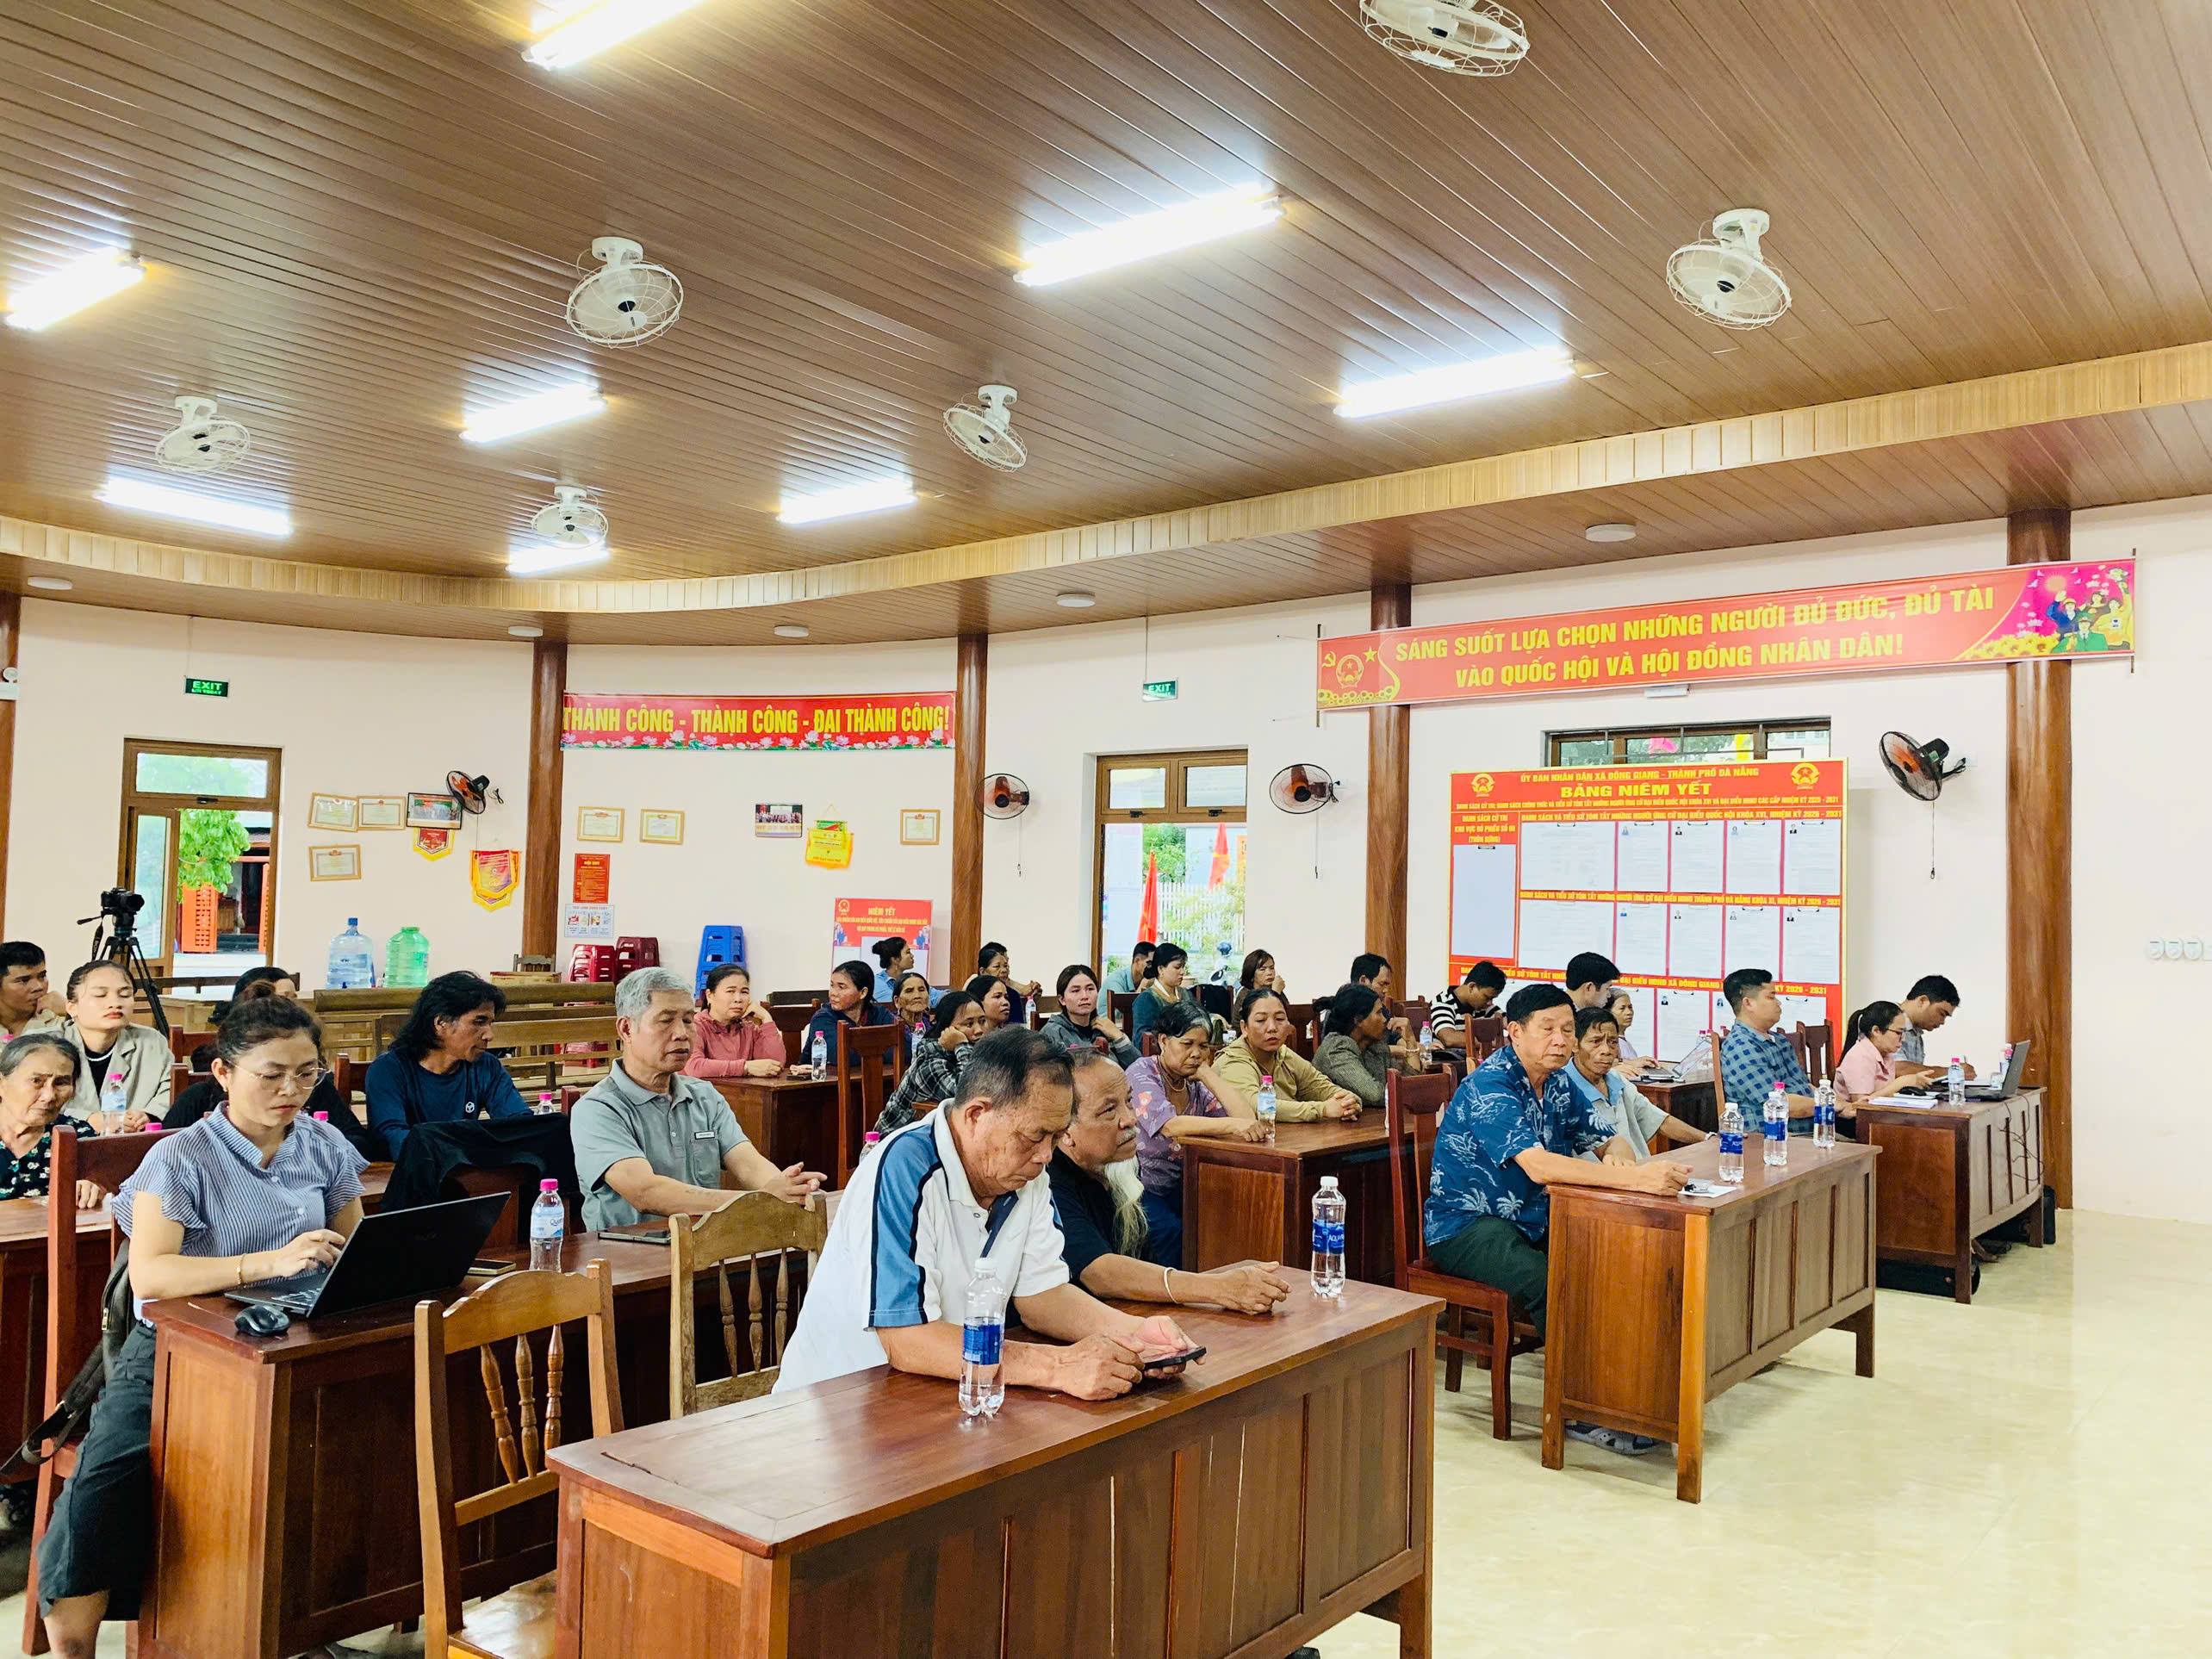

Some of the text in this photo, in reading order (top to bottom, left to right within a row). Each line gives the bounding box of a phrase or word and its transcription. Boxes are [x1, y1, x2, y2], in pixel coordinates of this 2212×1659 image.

[1395, 584, 1993, 662] SÁNG SUỐT LỰA CHỌN NHỮNG NGƯỜI ĐỦ ĐỨC, ĐỦ TÀI
[1455, 631, 1903, 688] VÀO QUỐC HỘI VÀ HỘI ĐỒNG NHÂN DÂN!
[193, 680, 222, 691] EXIT
[1148, 683, 1171, 693] EXIT
[562, 703, 620, 732] THÀNH
[625, 703, 674, 732] CÔNG
[691, 704, 748, 733] THÀNH
[752, 705, 798, 734] CÔNG
[845, 702, 897, 733] THÀNH
[901, 701, 950, 732] CÔNG!
[1618, 782, 1669, 797] NIÊM
[1675, 779, 1712, 795] YẾT
